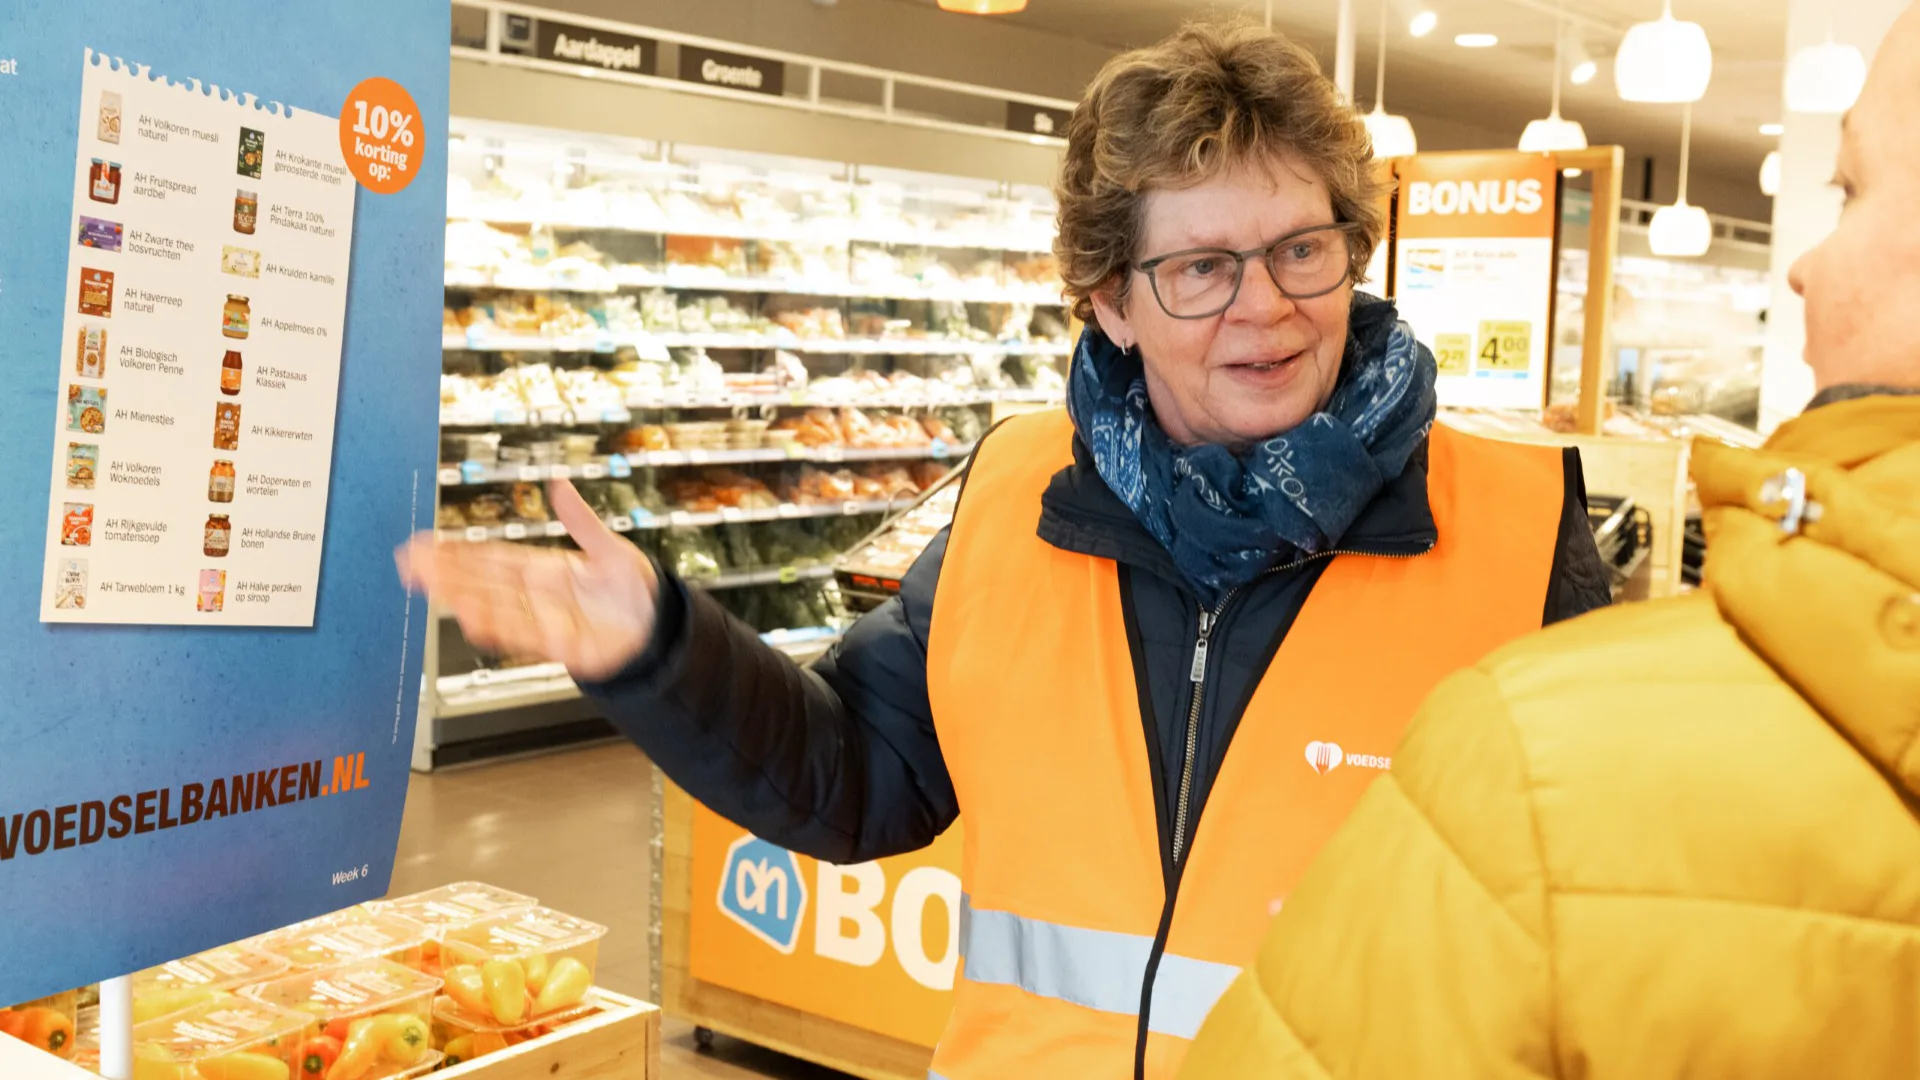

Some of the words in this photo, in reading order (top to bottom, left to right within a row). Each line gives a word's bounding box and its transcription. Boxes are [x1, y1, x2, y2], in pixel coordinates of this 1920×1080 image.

[554, 33, 641, 69] Aardappel
[702, 58, 762, 88] Groente
[138, 114, 152, 126] AH
[154, 118, 190, 136] Volkoren
[192, 128, 219, 143] muesli
[353, 100, 414, 147] 10%
[138, 127, 168, 142] naturel
[276, 149, 286, 160] AH
[289, 154, 321, 169] Krokante
[324, 163, 347, 176] muesli
[355, 136, 408, 172] korting
[274, 162, 318, 180] geroosterde
[321, 173, 341, 185] noten
[369, 162, 391, 182] op:
[134, 172, 146, 184] AH
[150, 176, 196, 194] Fruitspread
[133, 185, 166, 200] aardbei
[1408, 178, 1543, 215] BONUS
[270, 204, 282, 214] AH
[284, 206, 302, 219] Terra
[306, 212, 324, 224] 100%
[270, 214, 307, 231] Pindakaas
[310, 224, 334, 237] naturel
[130, 230, 142, 241] AH
[145, 233, 173, 248] Zwarte
[176, 239, 194, 252] thee
[128, 242, 181, 260] bosvruchten
[266, 263, 276, 273] AH
[279, 266, 308, 280] Kruiden
[310, 272, 335, 286] kamille
[124, 300, 154, 313] naturel
[125, 288, 137, 298] AH
[140, 290, 182, 308] Haverreep
[261, 317, 272, 328] AH
[274, 319, 314, 335] Appelmoes
[317, 327, 328, 338] 0%
[120, 346, 132, 356] AH
[136, 348, 178, 362] Biologisch
[120, 358, 156, 371] Volkoren
[158, 362, 184, 375] Penne
[257, 366, 268, 375] AH
[270, 368, 307, 382] Pastasaus
[256, 377, 286, 390] Klassiek
[115, 409, 128, 420] AH
[130, 411, 174, 426] Mienestjes
[252, 425, 262, 435] AH
[264, 428, 312, 441] Kikkererwten
[111, 460, 122, 470] AH
[126, 462, 162, 474] Volkoren
[110, 472, 160, 486] Woknoedels
[247, 474, 258, 484] AH
[260, 475, 300, 488] Doperwten
[302, 480, 312, 488] en
[246, 486, 278, 496] wortelen
[106, 518, 118, 528] AH
[121, 520, 168, 532] Rijkgevulde
[105, 531, 160, 544] tomatensoep
[242, 528, 252, 537] AH
[255, 528, 290, 540] Hollandse
[292, 531, 316, 541] Bruine
[241, 539, 264, 549] bonen
[100, 582, 112, 592] AH
[116, 582, 164, 593] Tarwebloem
[176, 584, 185, 596] kg
[236, 581, 248, 591] AH
[250, 582, 269, 592] Halve
[272, 582, 302, 593] perziken
[236, 594, 244, 603] op
[247, 594, 270, 604] siroop
[332, 866, 359, 886] Week
[361, 863, 369, 877] 6
